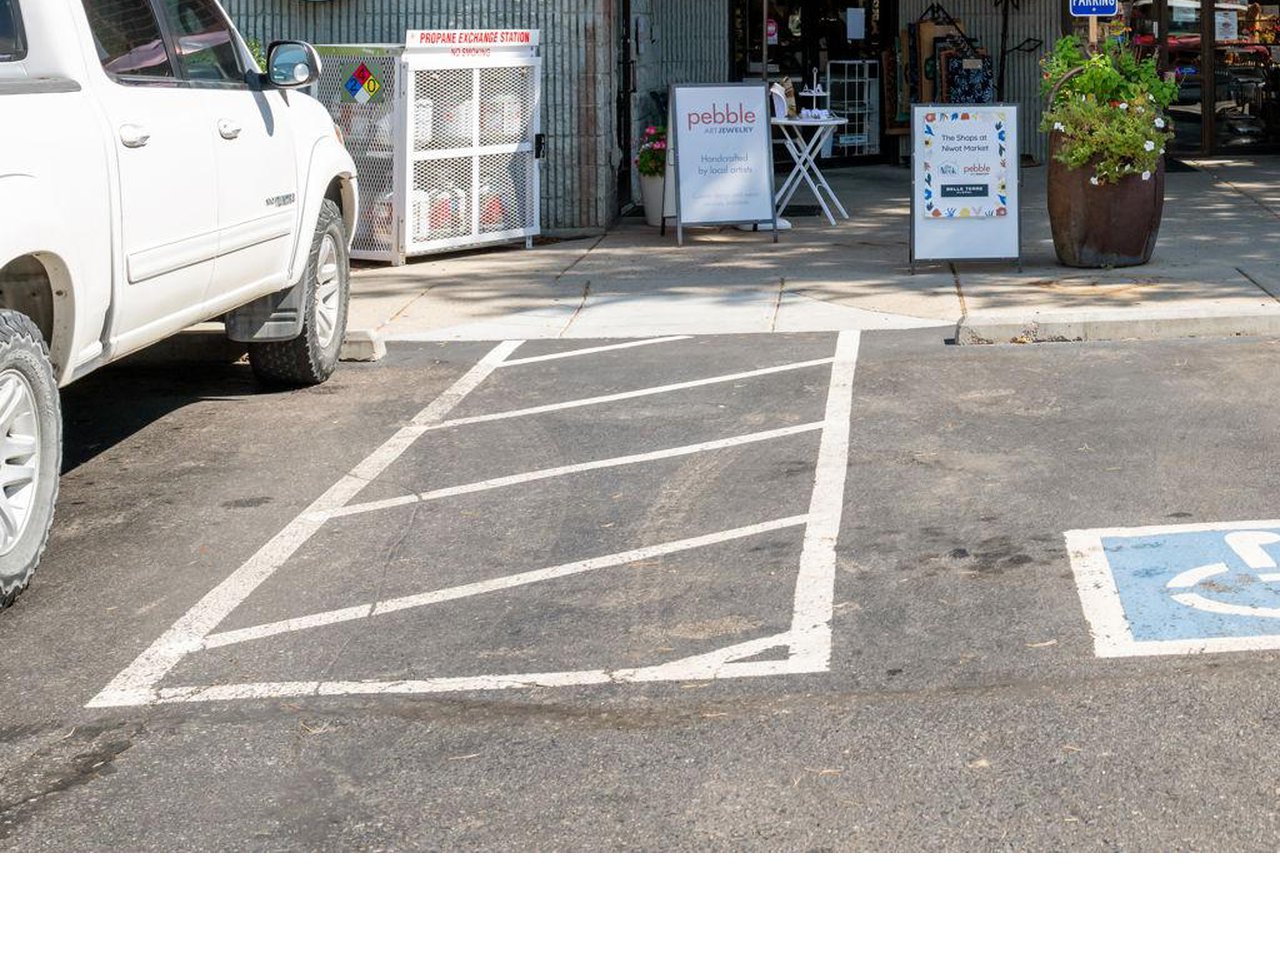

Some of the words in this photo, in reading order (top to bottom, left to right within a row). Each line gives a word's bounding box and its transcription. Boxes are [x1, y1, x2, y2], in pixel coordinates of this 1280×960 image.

[420, 32, 457, 44] PROPANE
[458, 32, 498, 44] EXCHANGE
[499, 31, 531, 43] STATION
[367, 78, 376, 93] 0
[688, 103, 755, 131] pebble
[701, 152, 749, 163] Handcrafted
[698, 167, 708, 176] by
[709, 165, 728, 175] local
[964, 163, 991, 174] pebble
